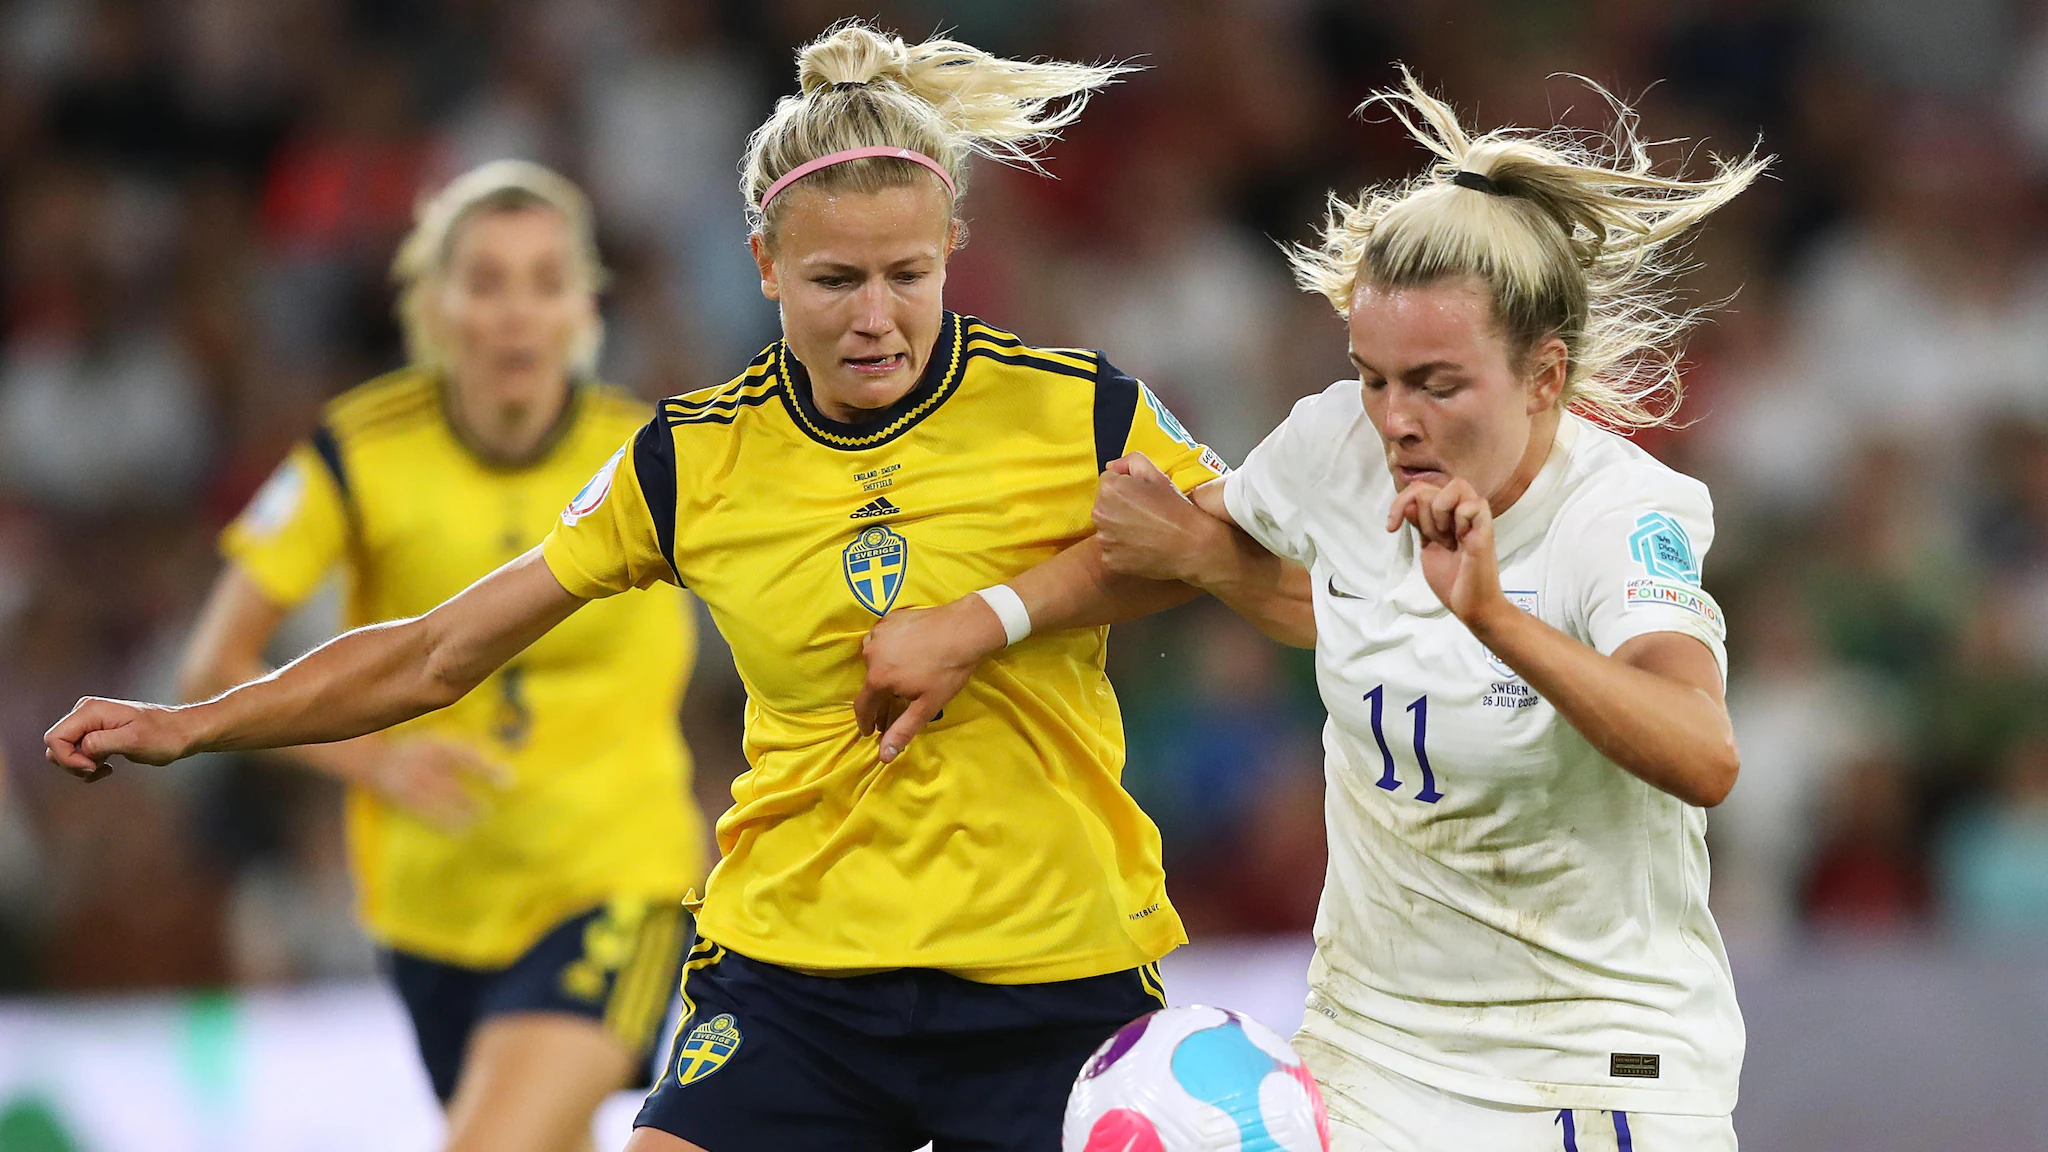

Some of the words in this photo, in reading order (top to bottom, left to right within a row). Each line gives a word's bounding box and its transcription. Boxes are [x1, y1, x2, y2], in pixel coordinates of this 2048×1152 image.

[854, 470, 878, 482] ENGLAND
[881, 464, 901, 475] SWEDEN
[863, 478, 893, 492] SHEFFIELD
[850, 507, 900, 518] adidas
[855, 546, 895, 560] SVERIGE
[1627, 579, 1654, 588] UEFA
[1627, 588, 1722, 628] FOUNDATION
[1491, 683, 1529, 696] SWEDEN
[1494, 696, 1517, 708] JULY
[1518, 695, 1539, 708] 2022
[1362, 683, 1446, 804] 11
[696, 1033, 731, 1045] SVERIGE
